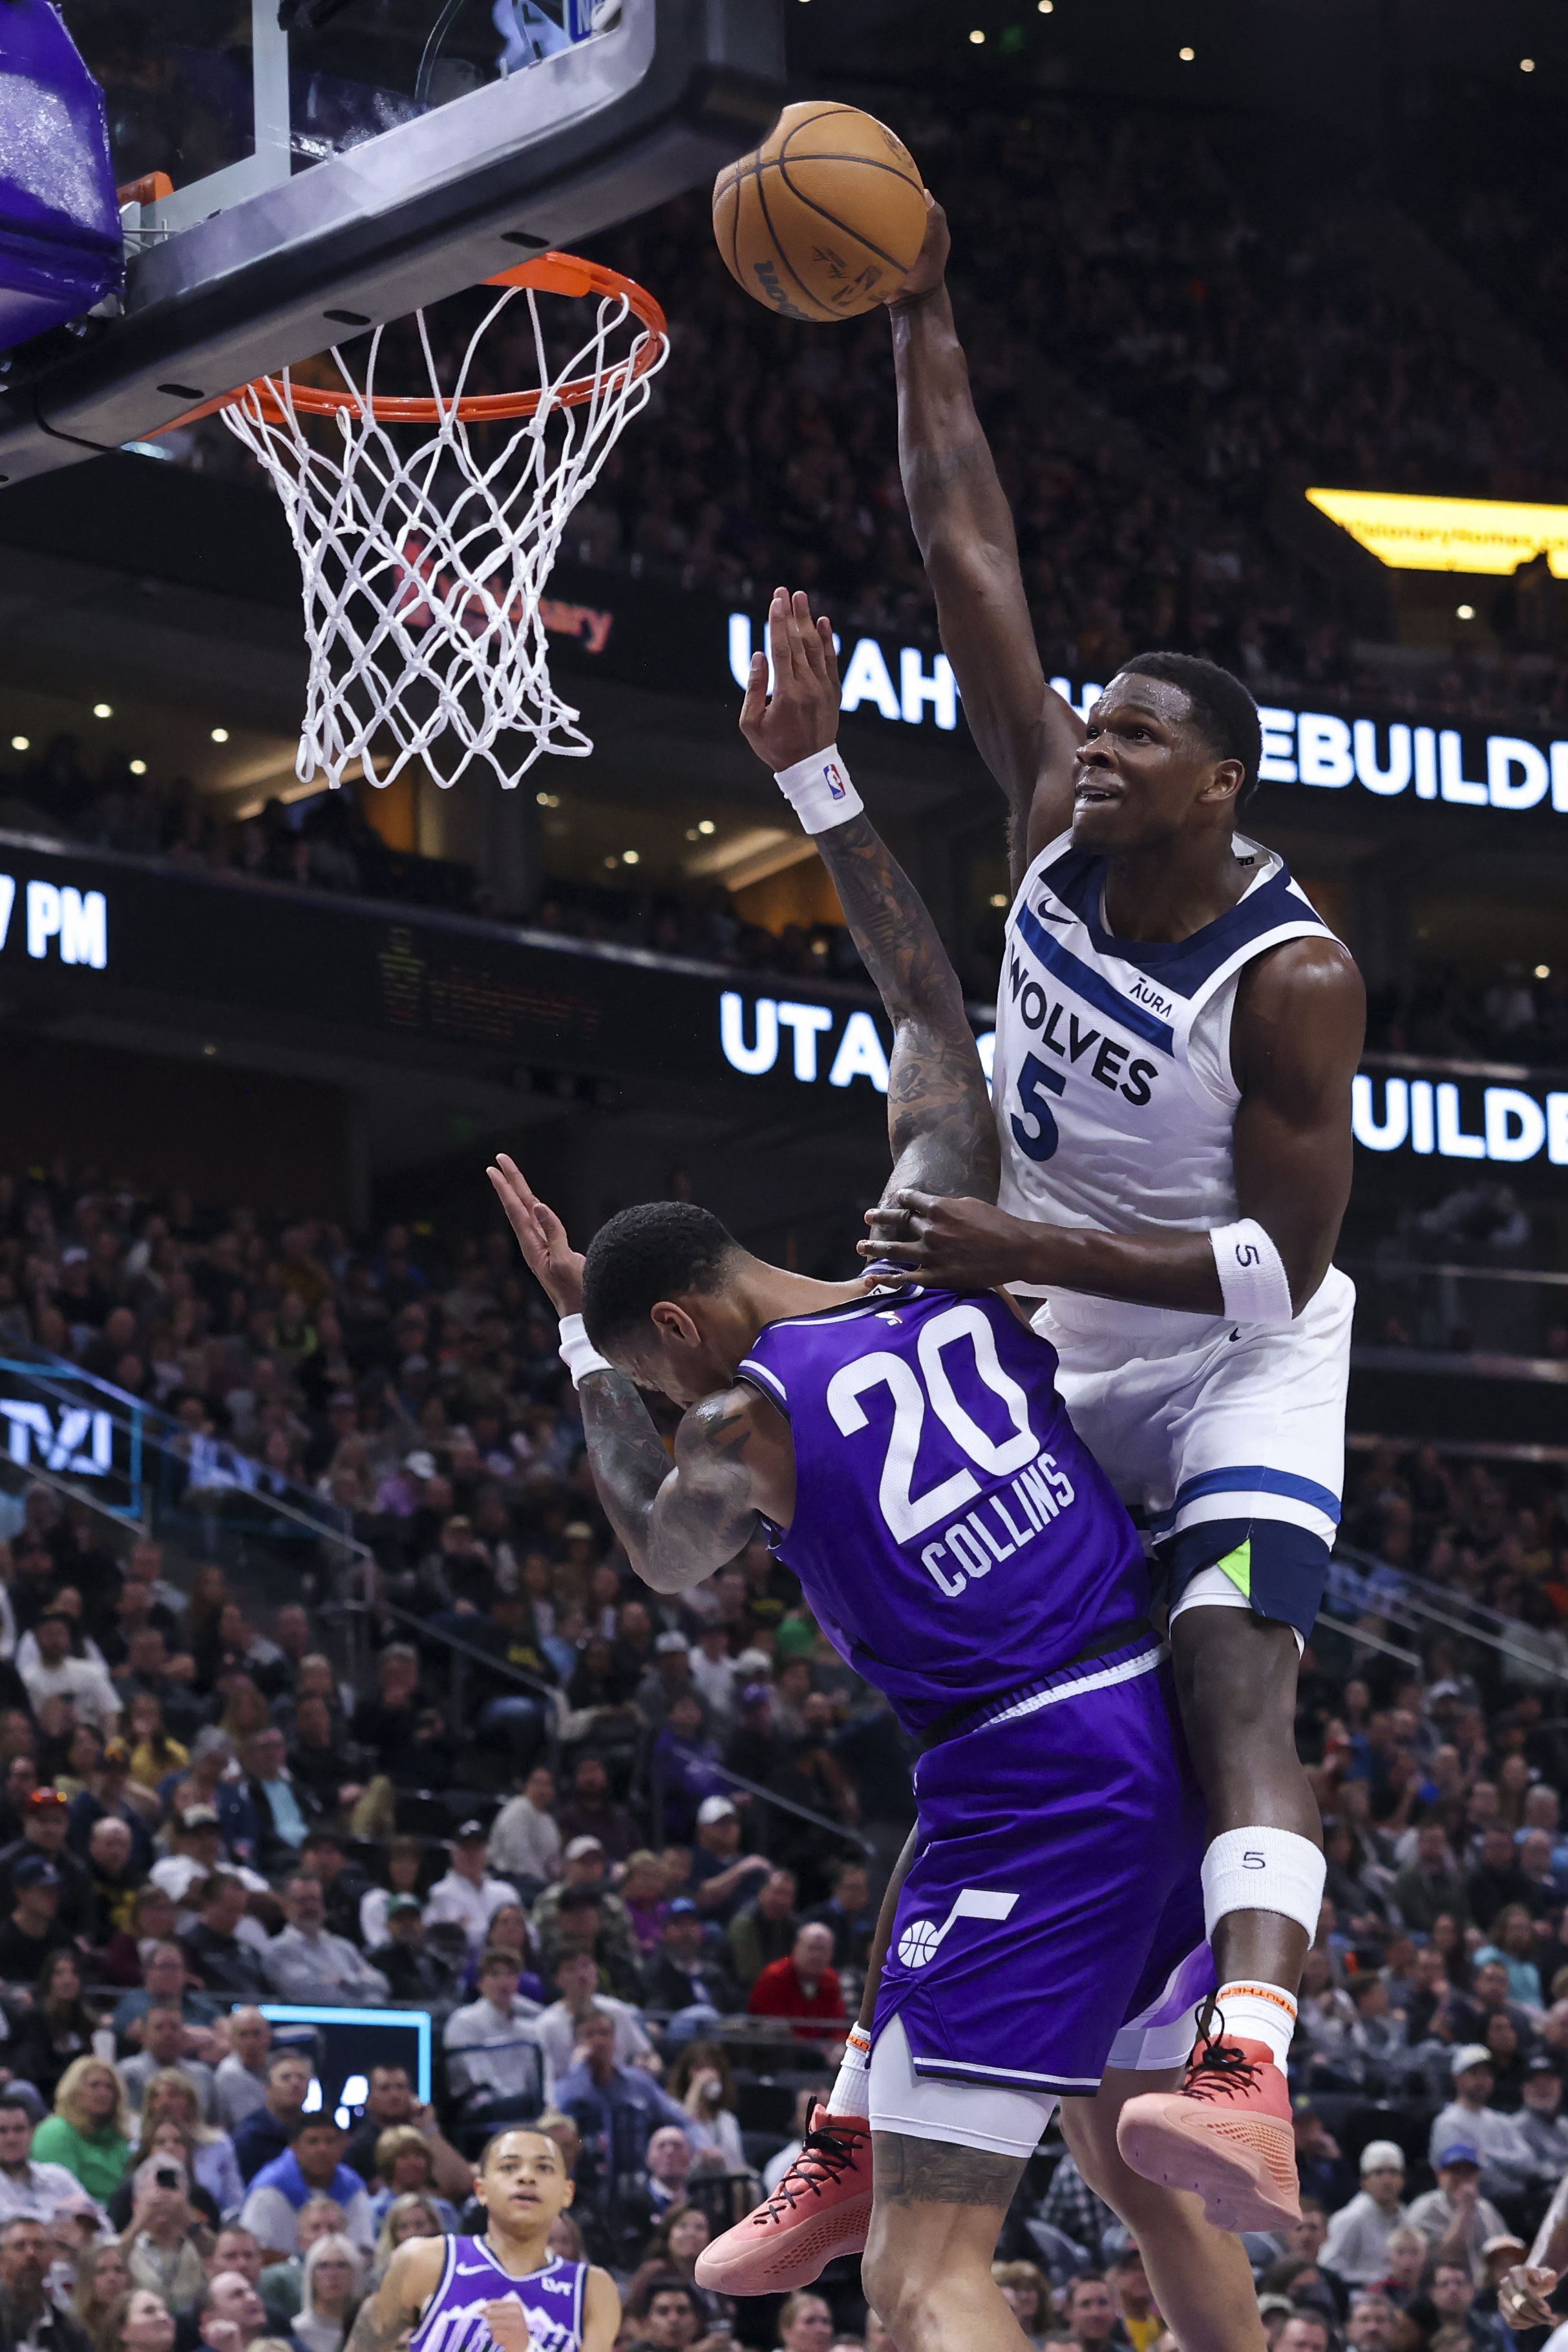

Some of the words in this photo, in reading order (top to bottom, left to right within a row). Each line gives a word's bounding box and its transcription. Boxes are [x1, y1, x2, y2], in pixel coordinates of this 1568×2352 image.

[729, 613, 958, 730] UAH
[26, 880, 107, 969] PM
[720, 991, 891, 1094] UTA
[1008, 942, 1159, 1106] WOLVES
[1010, 1051, 1066, 1162] 5
[1235, 1244, 1260, 1267] 5
[827, 1305, 1040, 1545] 20
[921, 1452, 1074, 1597] COLLINS
[1241, 1851, 1266, 1869] 5
